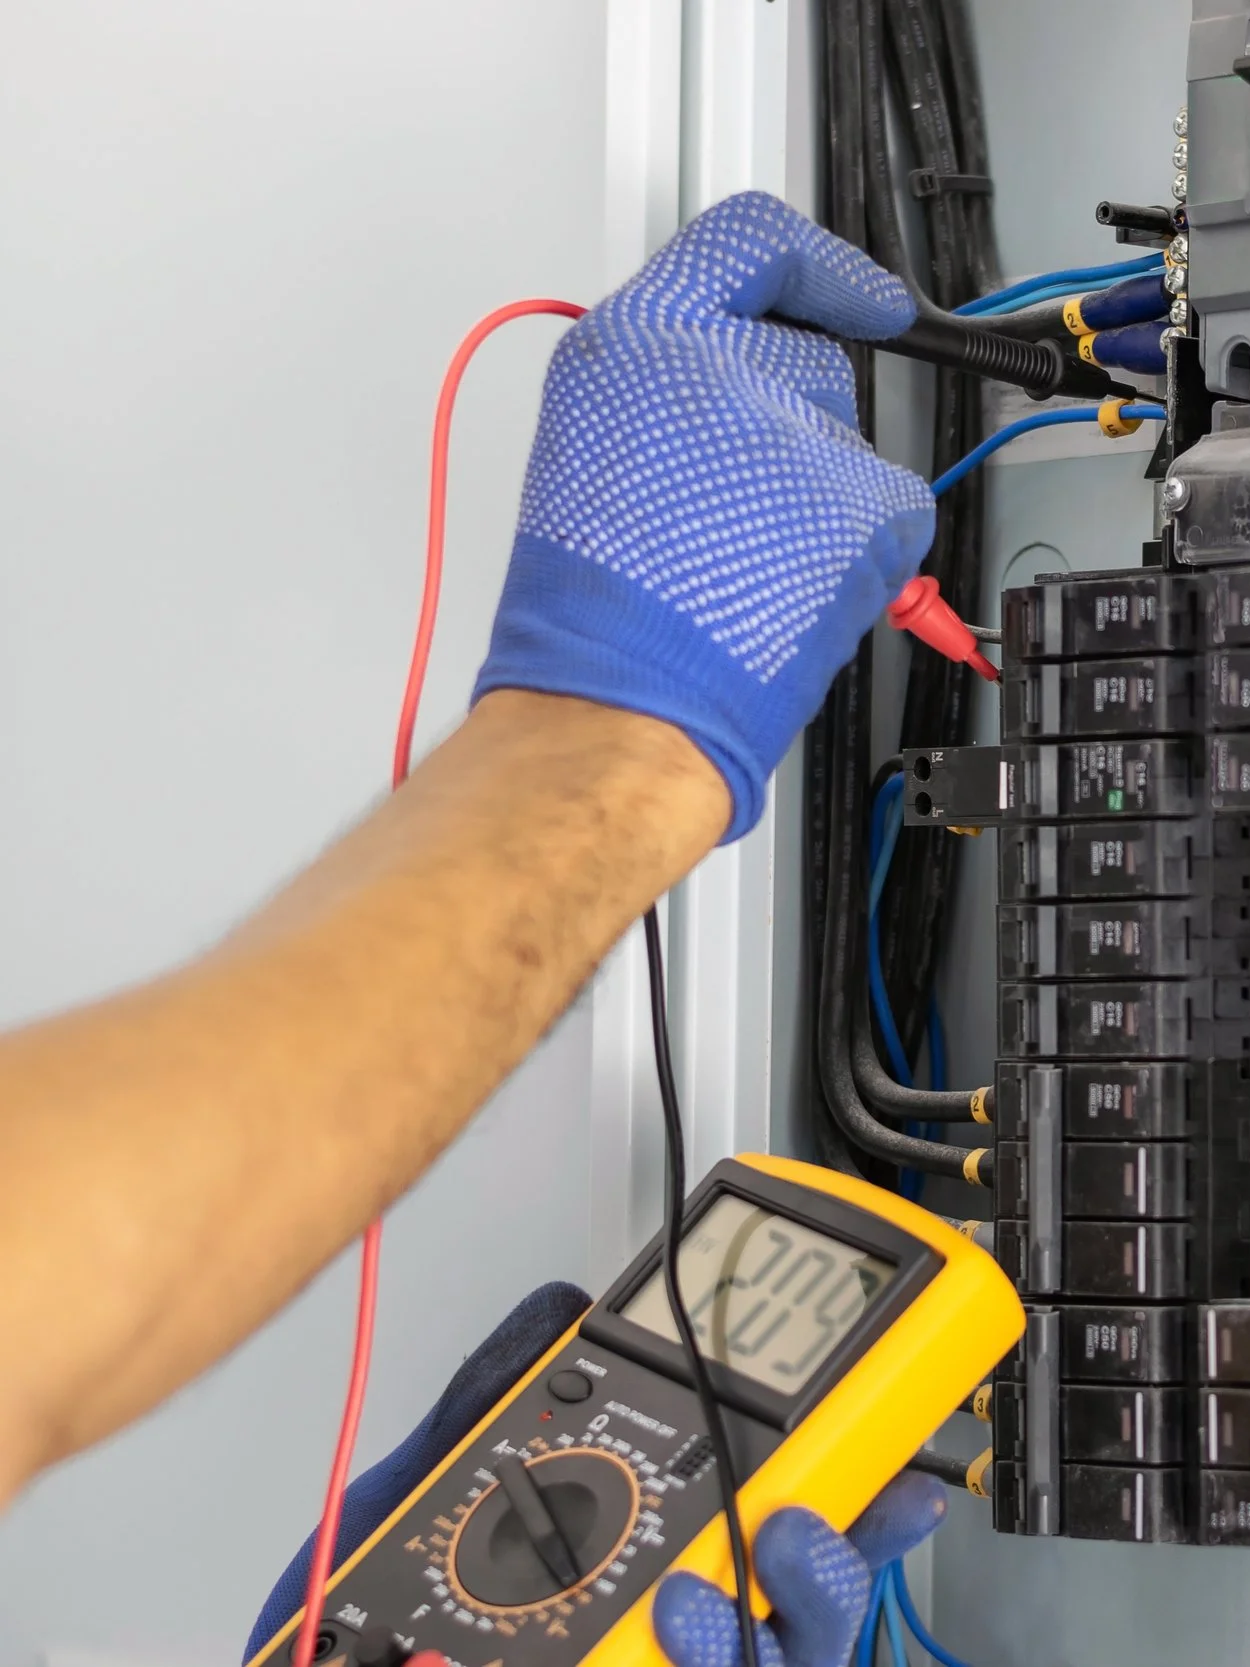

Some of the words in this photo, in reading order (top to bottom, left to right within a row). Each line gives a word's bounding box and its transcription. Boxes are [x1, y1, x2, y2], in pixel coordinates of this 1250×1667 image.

[1066, 313, 1077, 328] 2
[1083, 345, 1092, 360] 3
[1106, 424, 1119, 436] 5
[935, 751, 944, 762] N
[1007, 764, 1016, 793] Regular
[1008, 794, 1016, 808] test
[972, 1095, 979, 1112] 2
[576, 1358, 608, 1378] POWER
[977, 1397, 984, 1413] 3
[604, 1400, 631, 1417] AUTO
[629, 1410, 660, 1431] POWER
[657, 1424, 678, 1440] OFF
[971, 1482, 982, 1496] 3
[336, 1603, 369, 1629] 20A
